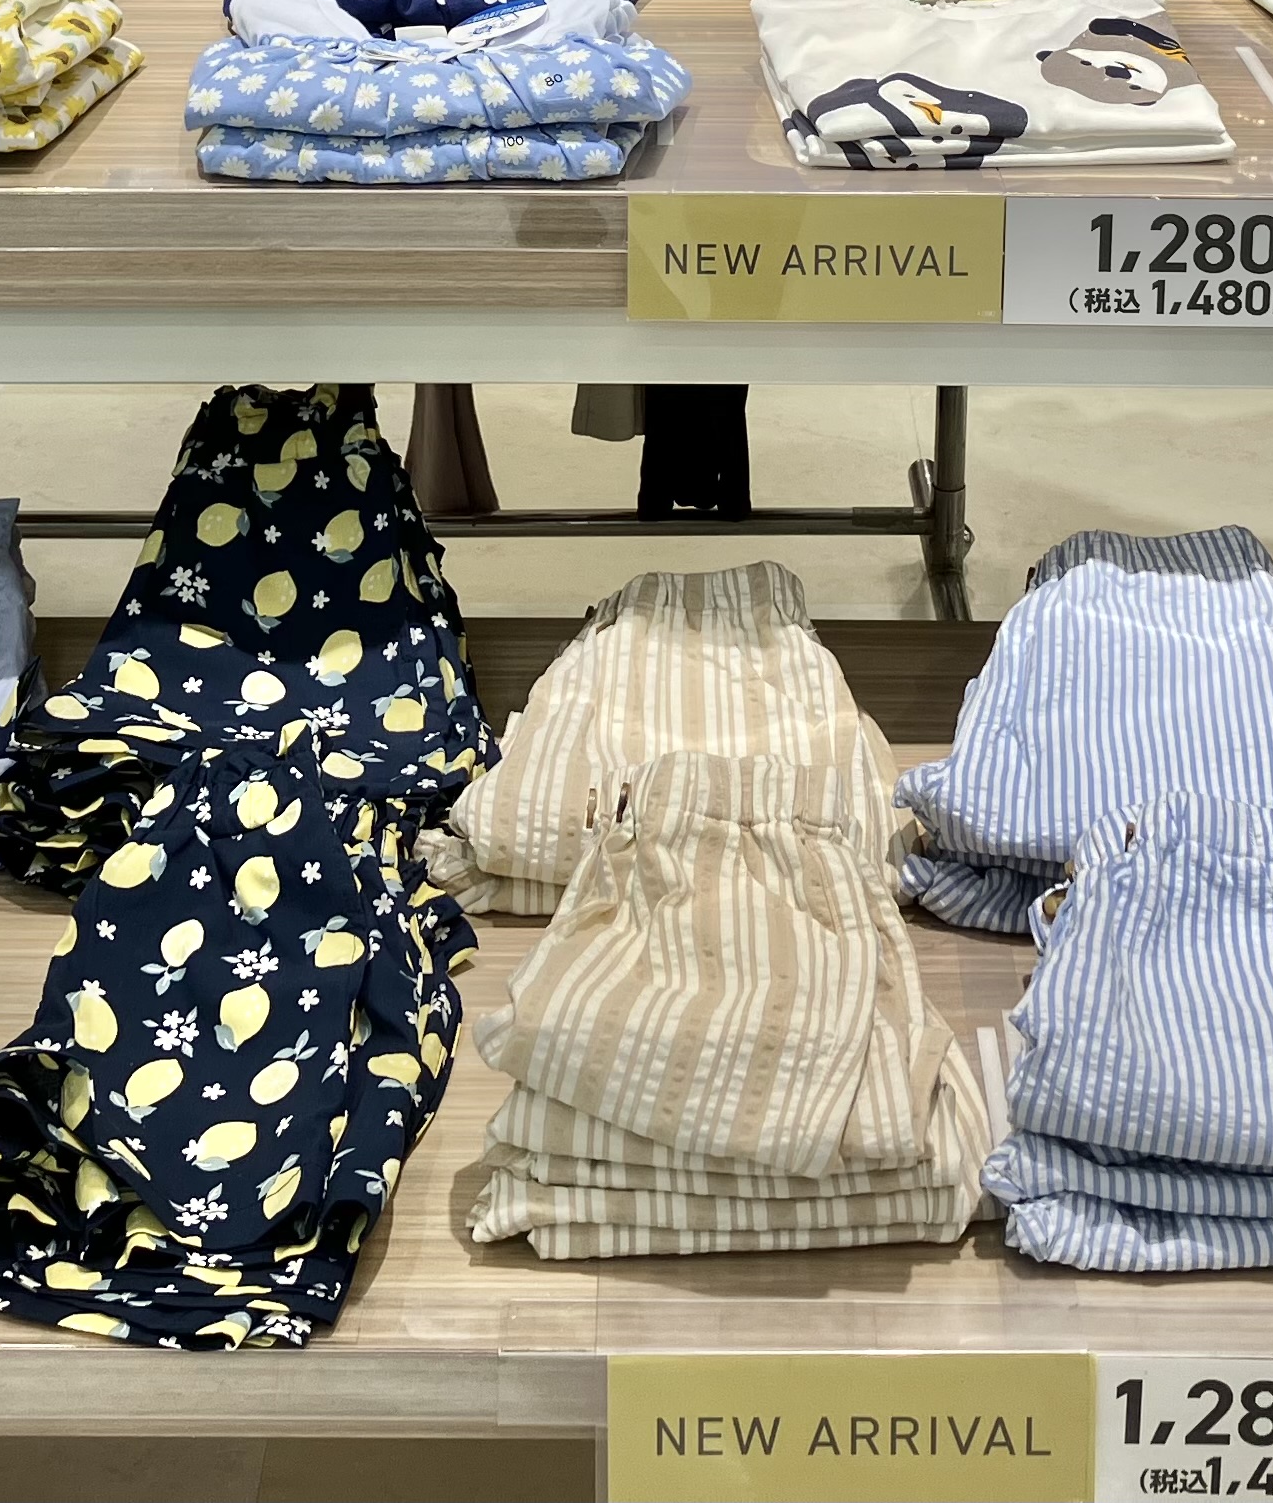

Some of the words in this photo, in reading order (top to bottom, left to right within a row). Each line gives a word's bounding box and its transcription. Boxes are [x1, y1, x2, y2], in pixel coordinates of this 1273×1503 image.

[544, 73, 563, 87] 80
[502, 135, 524, 148] 100
[664, 243, 761, 276] NEW
[781, 244, 969, 277] ARRIVAL
[655, 1416, 780, 1458] NEW
[808, 1416, 1051, 1458] ARRIVAL
